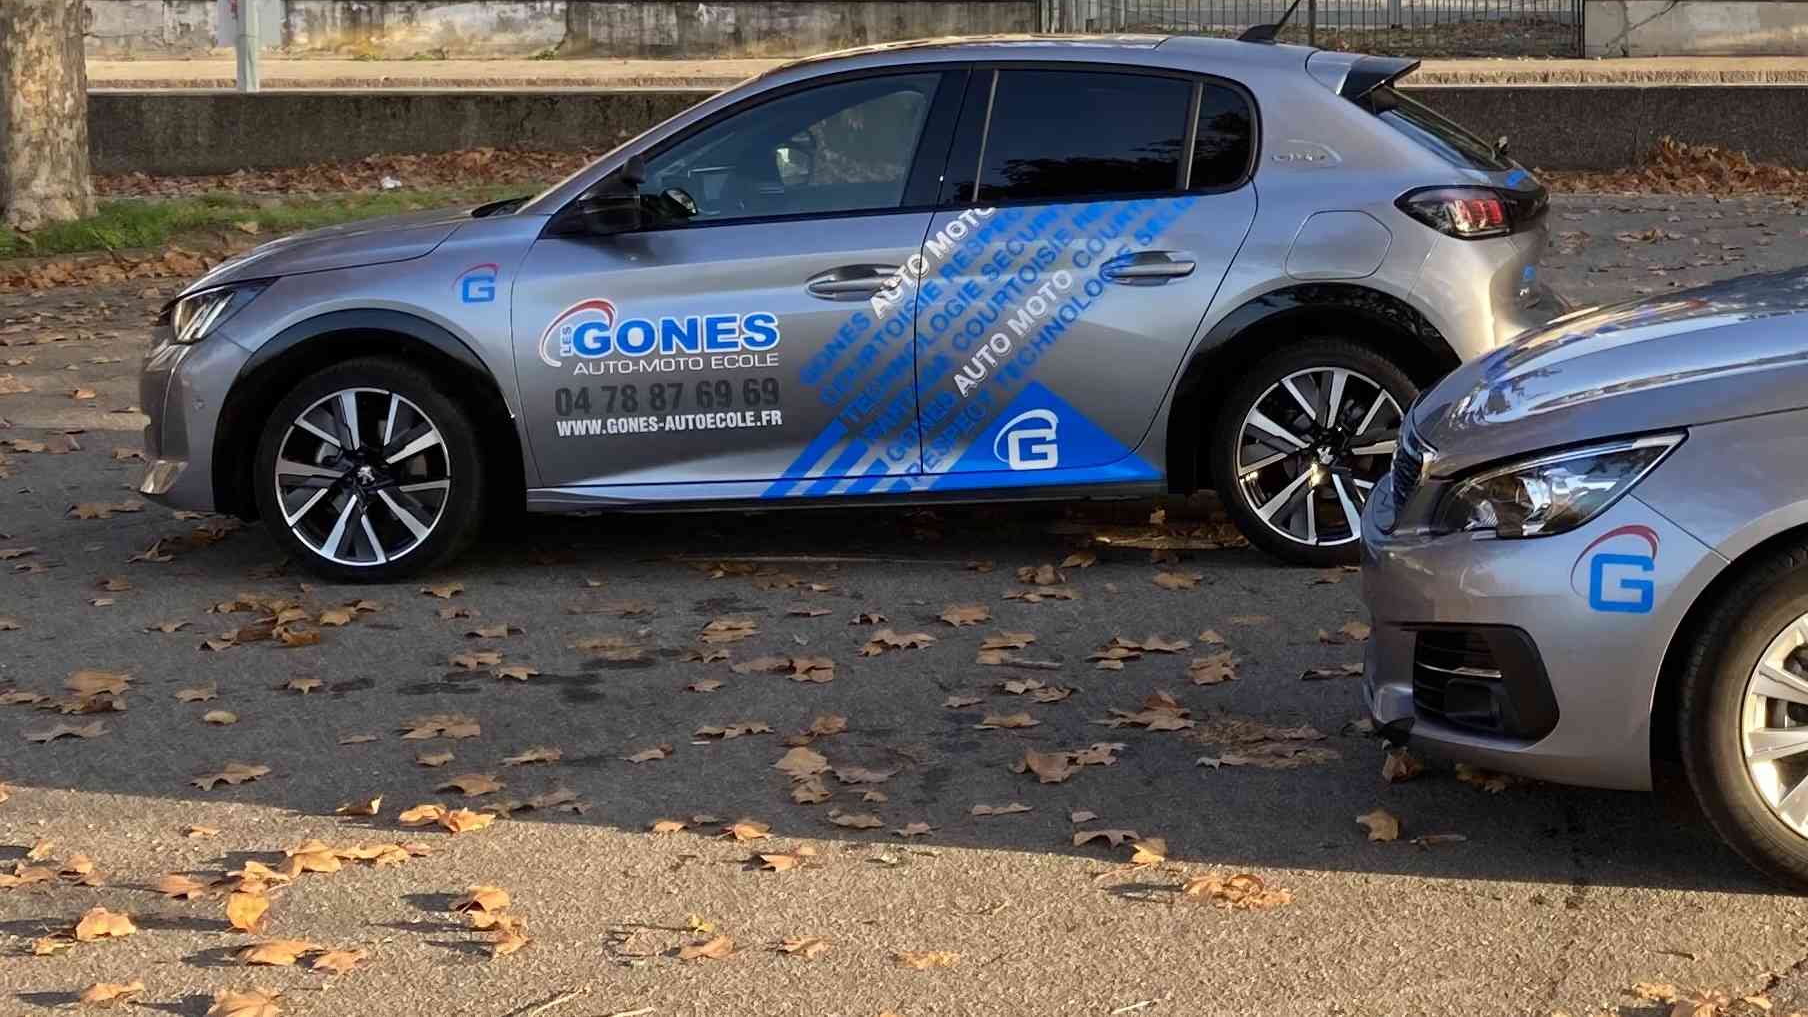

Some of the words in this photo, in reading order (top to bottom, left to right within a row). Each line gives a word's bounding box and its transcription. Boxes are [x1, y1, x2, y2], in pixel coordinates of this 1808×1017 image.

[462, 276, 495, 303] G
[870, 253, 929, 320] AUTO
[560, 326, 573, 356] LES
[573, 312, 781, 359] GONES
[953, 333, 1013, 399] AUTO
[1007, 269, 1073, 337] MOTO
[573, 357, 703, 375] AUTO-MOTO
[711, 352, 779, 369] ECOLE
[555, 387, 591, 416] 04
[601, 384, 638, 413] 78
[650, 382, 684, 411] 87
[696, 380, 732, 408] 69
[743, 377, 780, 406] 69
[556, 410, 782, 436] WWW.GONES-AUTOECOLE.FR
